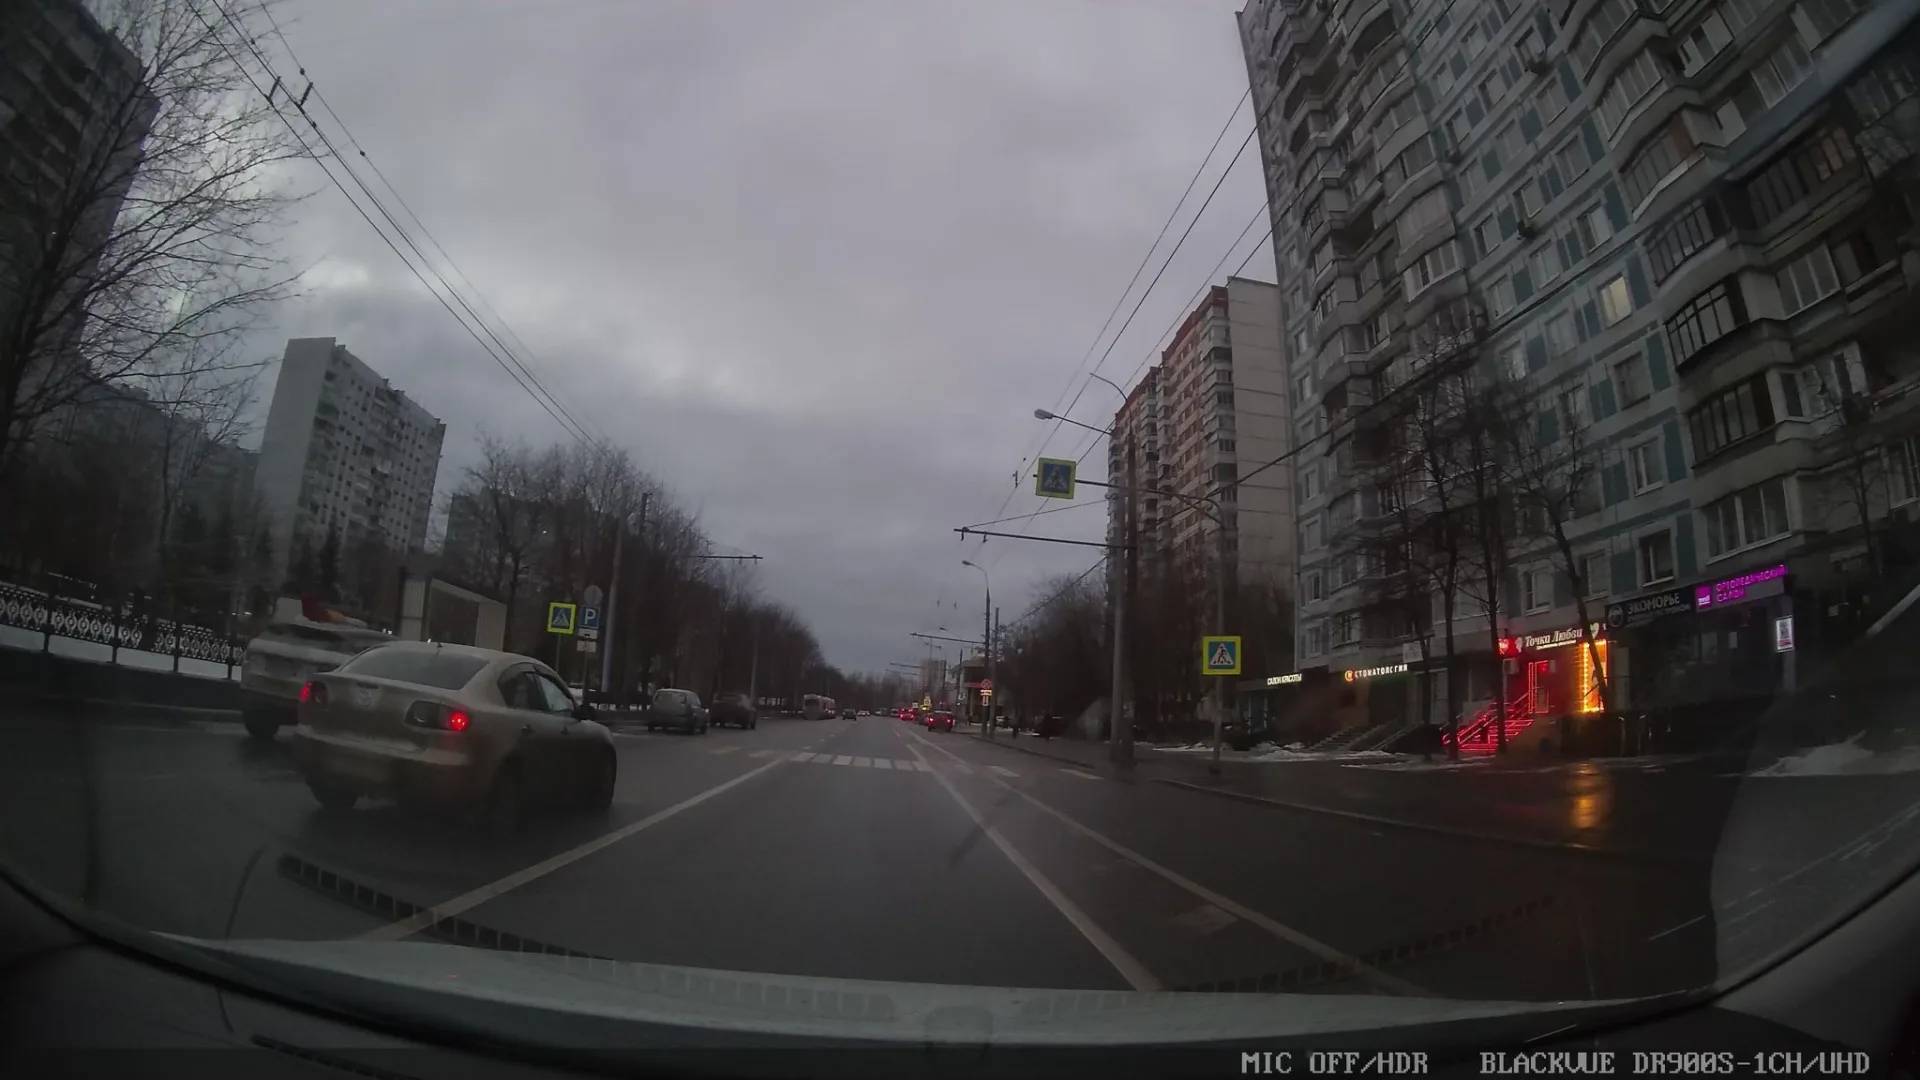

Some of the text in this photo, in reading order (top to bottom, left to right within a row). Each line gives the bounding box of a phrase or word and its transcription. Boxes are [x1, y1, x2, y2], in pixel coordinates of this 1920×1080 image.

[1627, 592, 1680, 615] ЭКОМОРЬЕ
[1717, 588, 1744, 602] САЛОН
[584, 608, 596, 625] P
[1525, 635, 1550, 647] Точка
[1552, 627, 1583, 642] Любви
